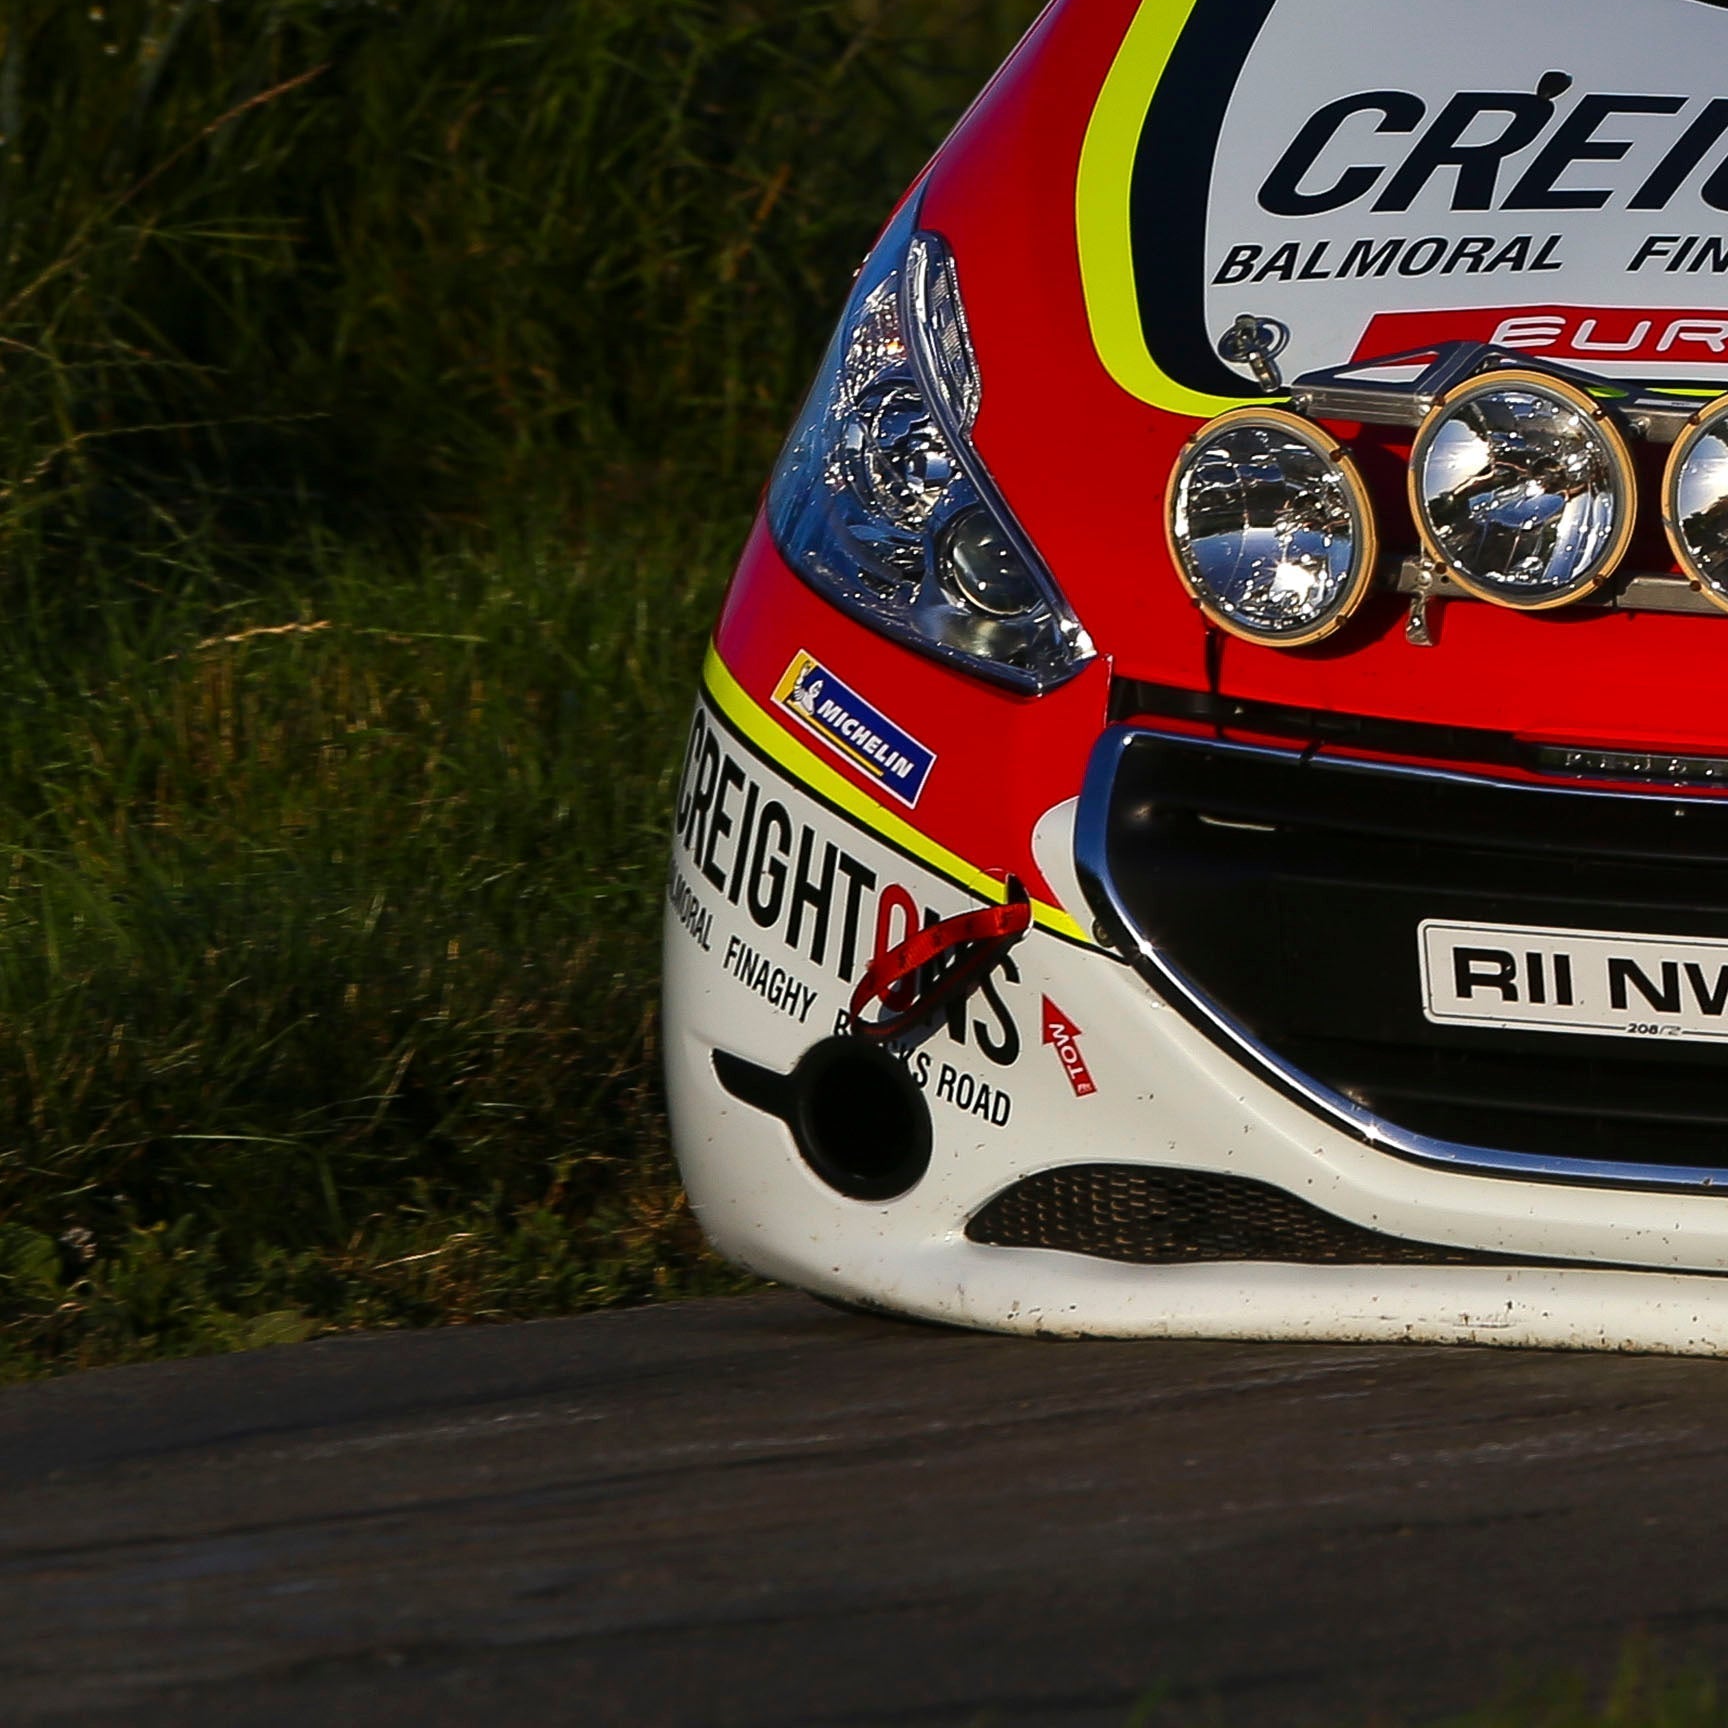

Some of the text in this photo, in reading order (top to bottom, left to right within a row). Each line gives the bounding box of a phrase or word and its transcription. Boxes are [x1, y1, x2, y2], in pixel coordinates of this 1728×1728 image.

[1213, 233, 1565, 286] BALMORAL
[816, 697, 915, 780] MICHELIN
[723, 933, 818, 1024] FINAGHY
[937, 1063, 1012, 1128] ROAD
